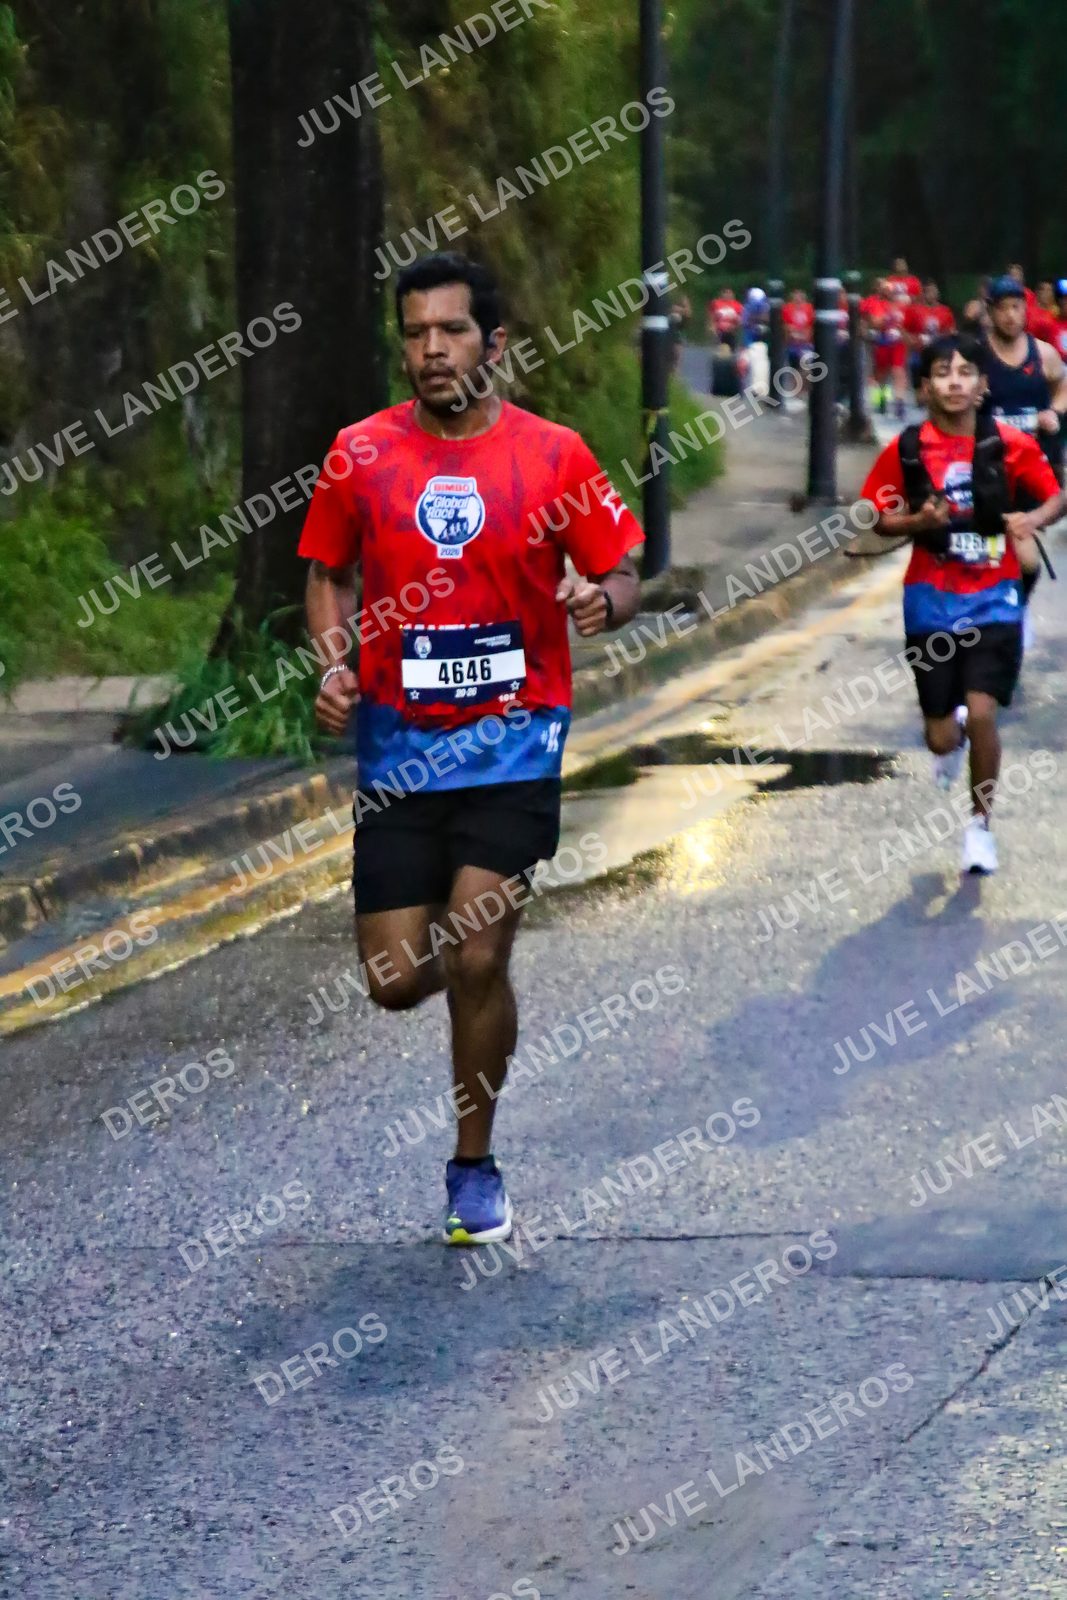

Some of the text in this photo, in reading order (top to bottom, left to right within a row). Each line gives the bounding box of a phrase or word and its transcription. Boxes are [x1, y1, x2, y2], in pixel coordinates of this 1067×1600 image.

[433, 496, 469, 508] Global
[426, 507, 455, 519] Race
[438, 658, 492, 684] 4646
